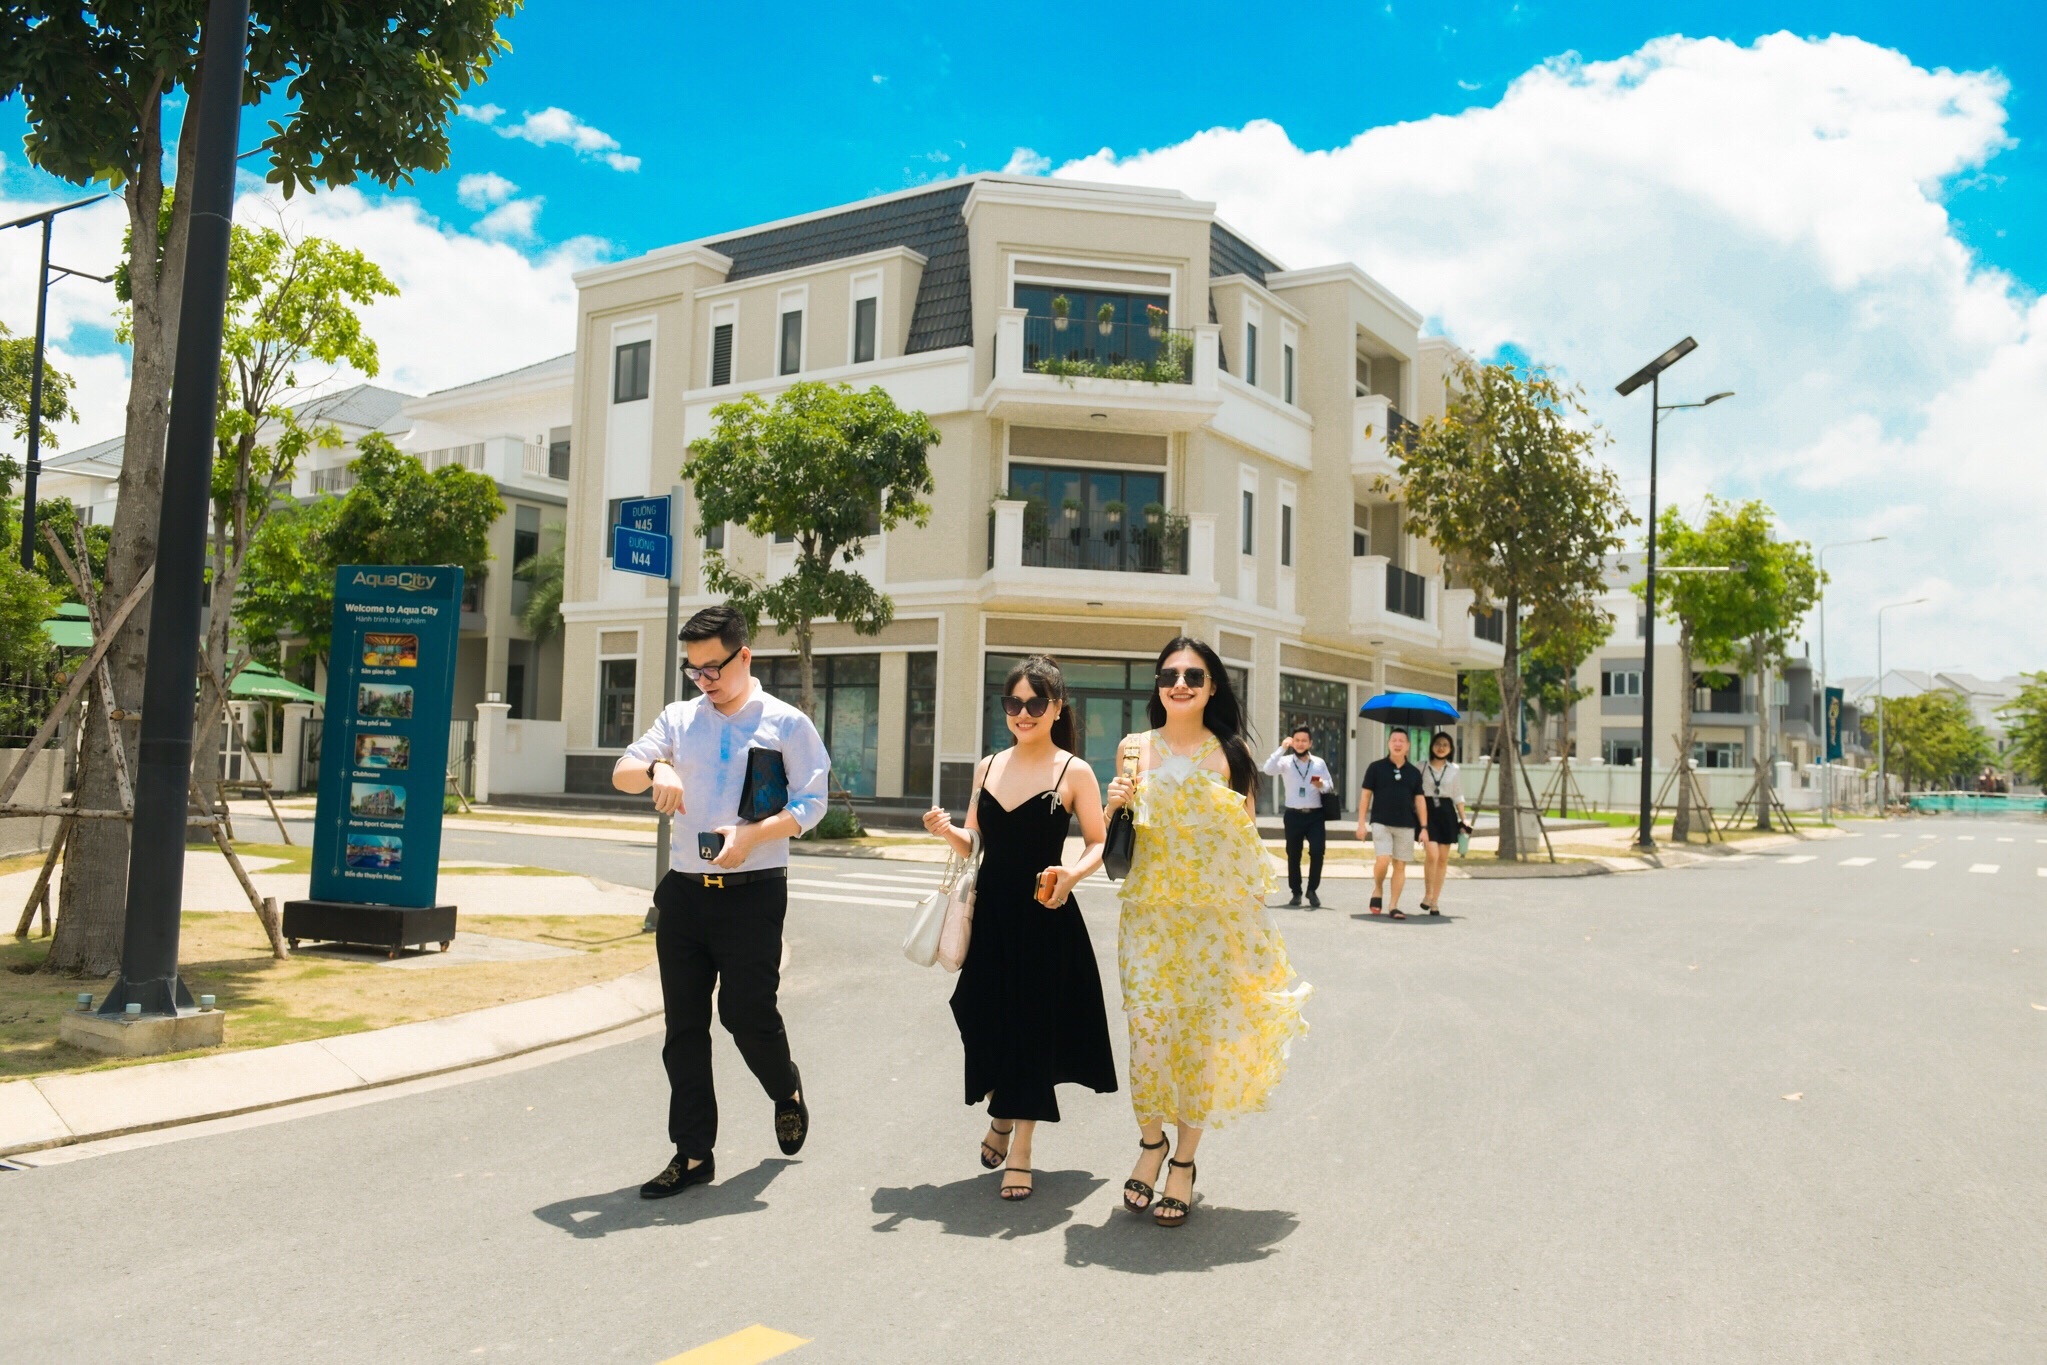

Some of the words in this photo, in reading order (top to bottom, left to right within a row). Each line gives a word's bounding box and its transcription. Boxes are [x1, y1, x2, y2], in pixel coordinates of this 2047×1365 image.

[635, 518, 653, 531] N45
[631, 551, 651, 567] N44
[345, 603, 384, 613] Welcome
[385, 605, 396, 614] to
[397, 605, 419, 615] Aqua
[421, 606, 438, 616] City
[352, 770, 381, 778] Clubhouse
[349, 820, 363, 828] Aqua
[364, 820, 379, 828] Sport
[383, 873, 402, 881] Marina
